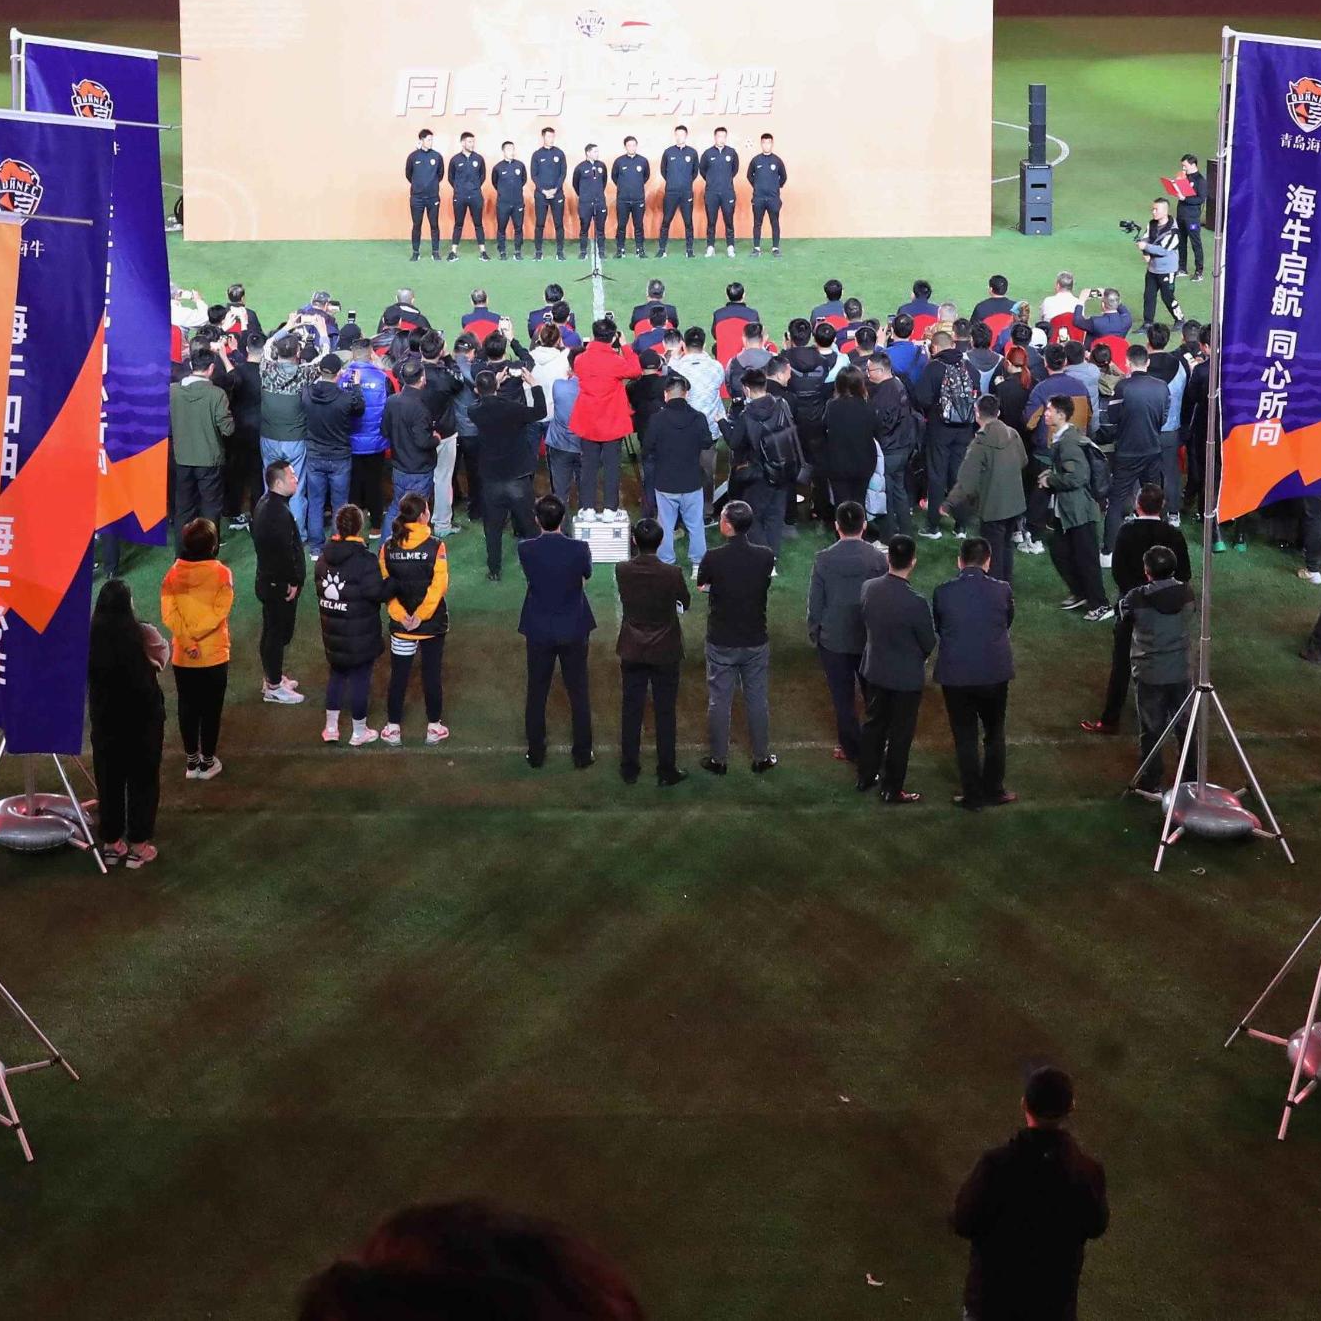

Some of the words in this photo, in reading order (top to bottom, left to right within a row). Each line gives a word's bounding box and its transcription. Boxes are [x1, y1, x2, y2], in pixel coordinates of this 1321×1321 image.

[396, 69, 565, 116] 同青岛
[1270, 183, 1317, 318] 海牛启航
[1251, 329, 1298, 447] 同心所向
[389, 552, 421, 560] KELME
[319, 599, 348, 612] KELME
